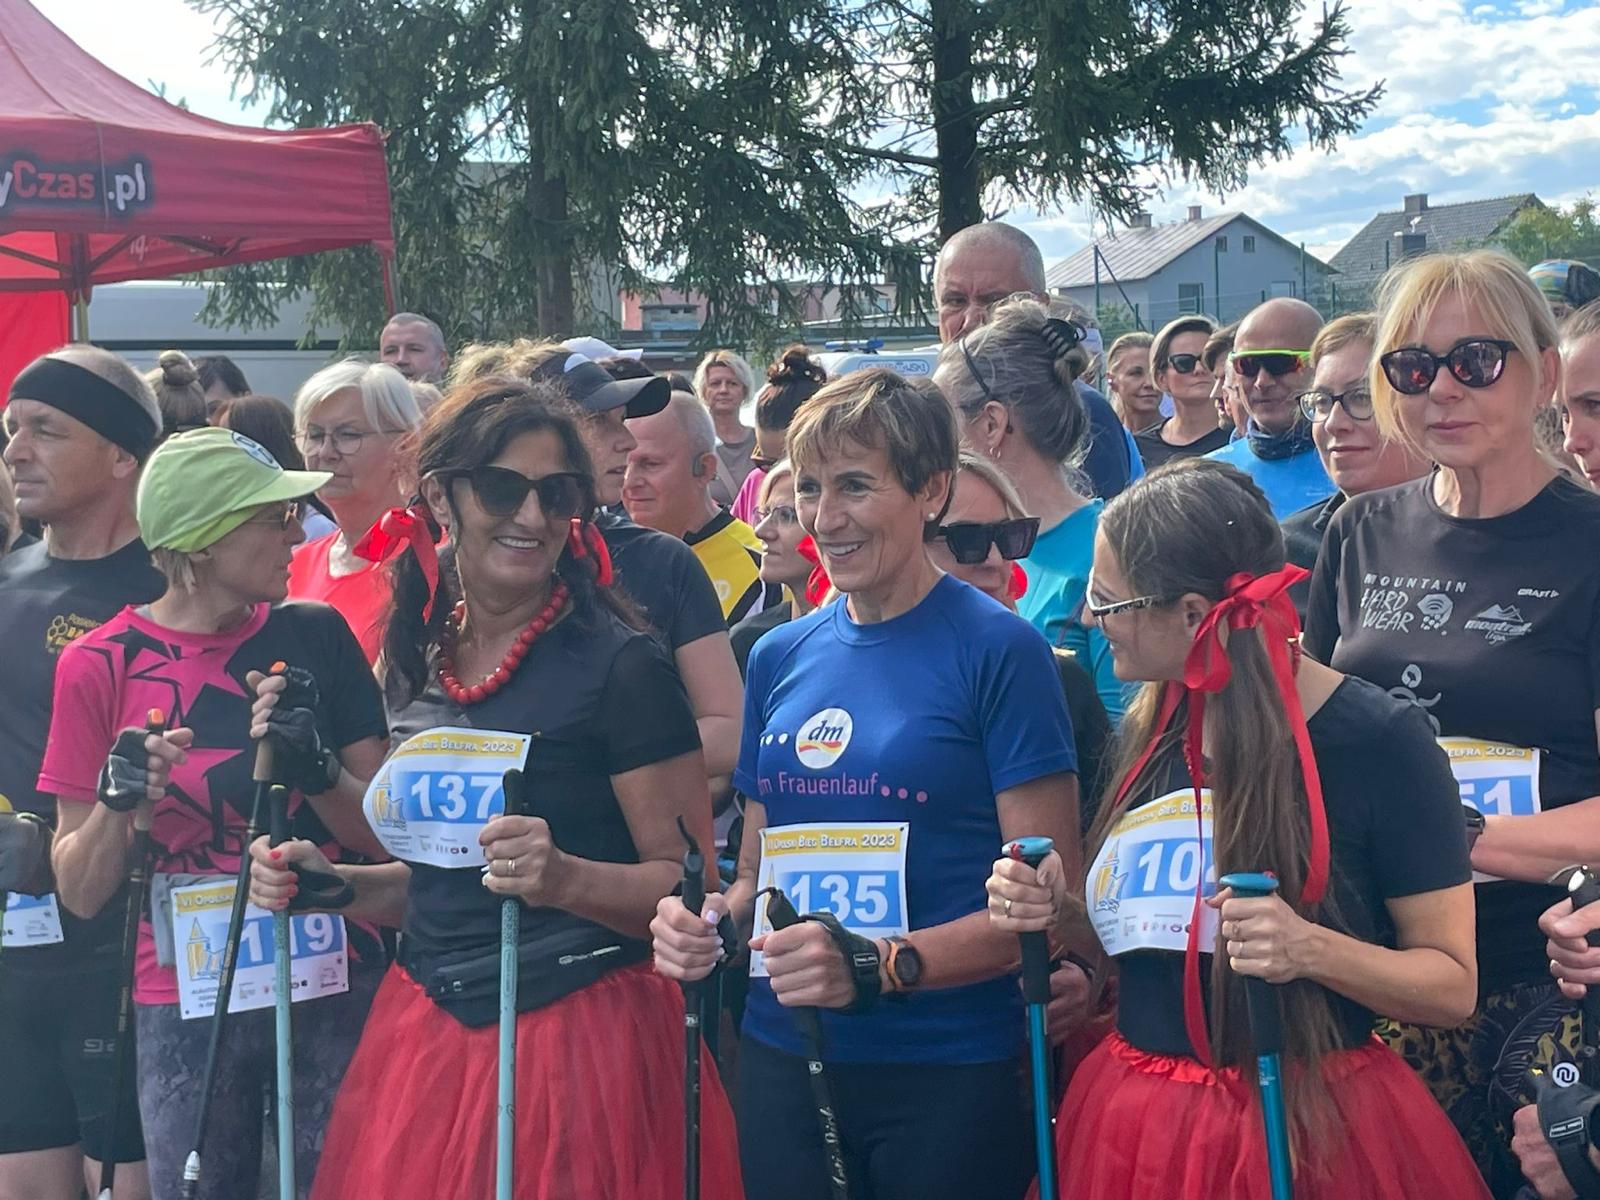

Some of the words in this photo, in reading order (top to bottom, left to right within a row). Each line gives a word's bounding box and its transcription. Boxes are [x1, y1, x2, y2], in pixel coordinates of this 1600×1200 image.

[1363, 573, 1467, 593] MOUNTAIN
[1360, 588, 1409, 612] HARD
[1362, 608, 1415, 633] WEAR
[808, 720, 844, 742] dm
[778, 770, 879, 796] Frauenlauf
[411, 774, 504, 820] 137
[861, 833, 896, 848] 2023
[791, 873, 888, 923] 135
